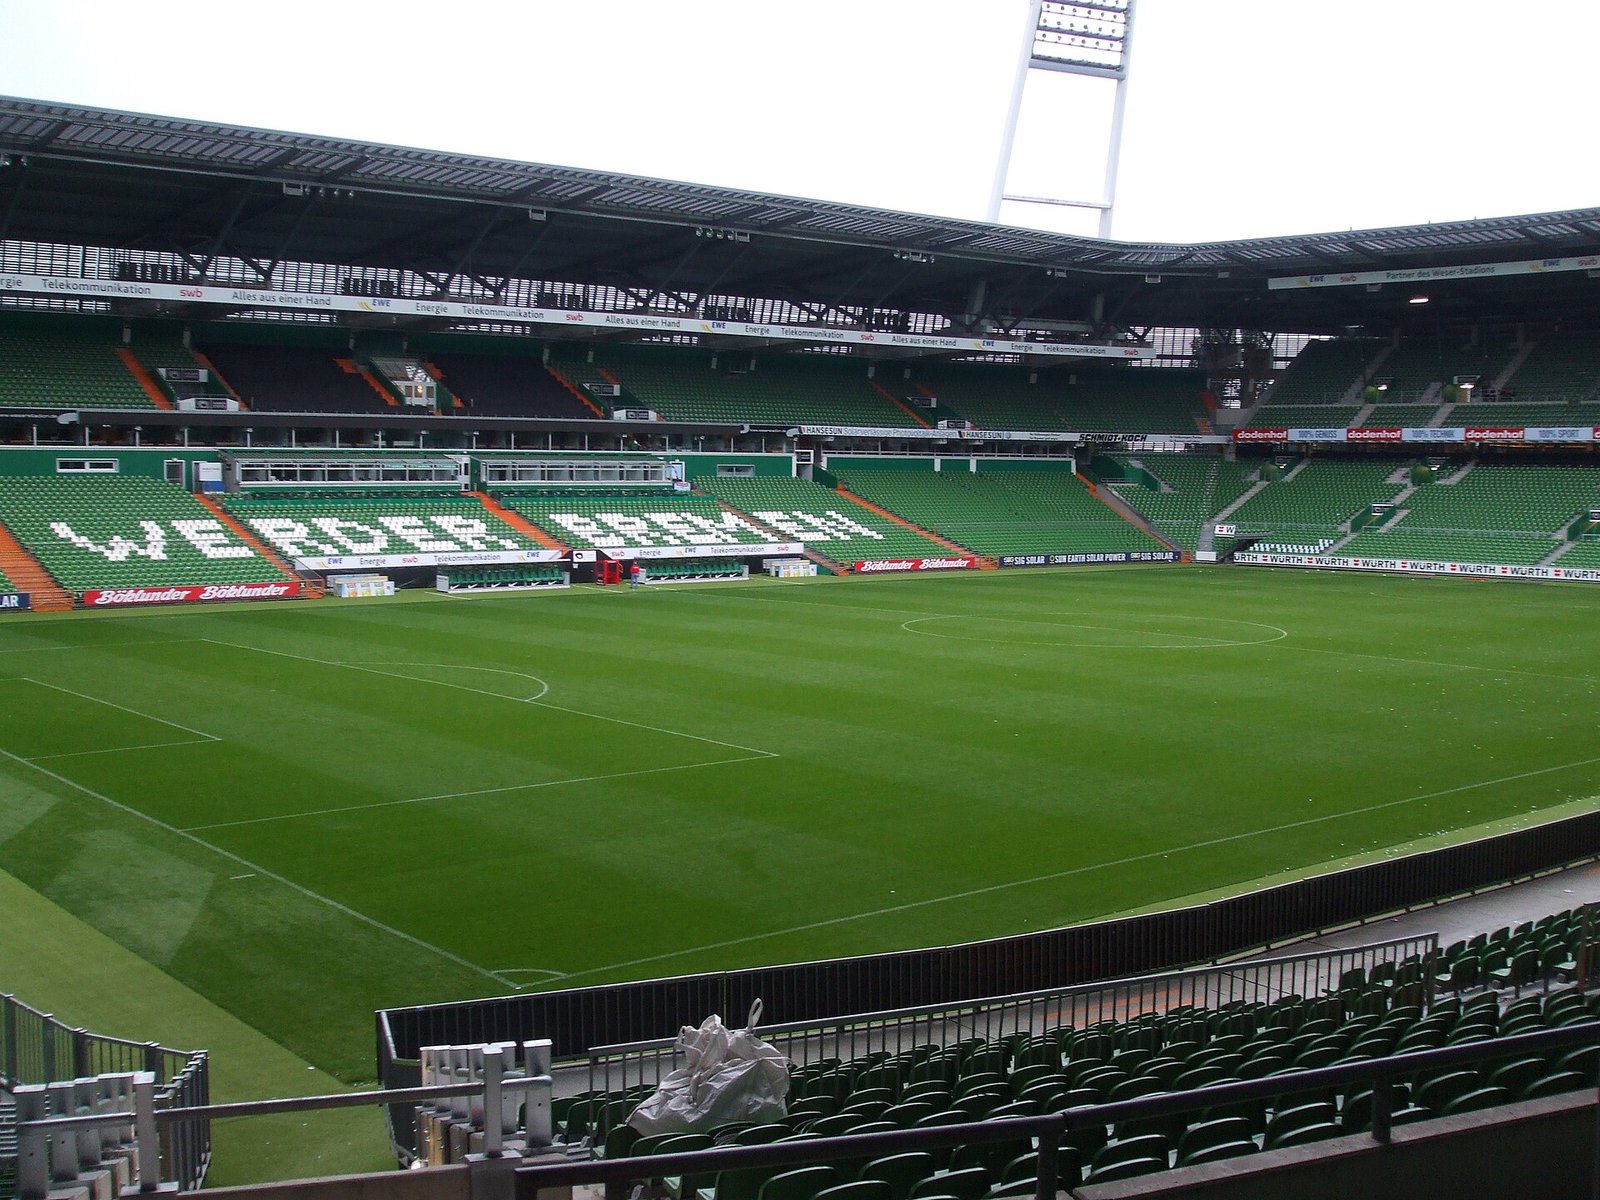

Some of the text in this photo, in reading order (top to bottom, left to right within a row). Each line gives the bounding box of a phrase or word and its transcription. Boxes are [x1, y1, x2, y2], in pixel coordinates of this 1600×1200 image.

[1386, 271, 1415, 279] Partner
[42, 278, 151, 295] Telekommunikation
[180, 288, 203, 298] swb
[232, 290, 331, 306] Alles aus einer Hand
[372, 298, 391, 307] EWE
[415, 302, 448, 314] Energie
[462, 305, 544, 320] Telekommunikation
[566, 312, 584, 322] swb
[605, 315, 681, 329] Alles aus einer Hand
[712, 321, 726, 329] EWE
[745, 325, 770, 336] Energie
[781, 327, 844, 340] Telekommunikation
[860, 334, 875, 342] swb
[891, 335, 909, 344] Alles
[922, 338, 938, 346] einer
[939, 339, 957, 348] Hand
[1011, 343, 1033, 352] Energie
[1043, 344, 1106, 356] Telekommunikation
[807, 426, 843, 435] HANSESUN
[967, 430, 1003, 439] HANSESUN
[1237, 429, 1287, 439] dodenhof
[1348, 429, 1402, 439] dodenhof
[1466, 429, 1524, 439] dodenhof
[49, 510, 885, 562] WERDER BREMEN
[527, 551, 540, 559] EWE
[639, 549, 662, 558] Energie
[685, 546, 697, 554] EWE
[711, 546, 765, 556] Telekommunikation
[402, 556, 418, 564] swb
[434, 553, 501, 563] Telekommunikation
[1026, 555, 1045, 564] SOLAR
[1055, 553, 1126, 564] SUN EARTH SOLAR POWER
[1152, 551, 1174, 560] SOLAR
[1270, 555, 1303, 564] WÜRTH
[328, 557, 343, 565] EWE
[359, 557, 386, 567] Energie
[861, 560, 914, 572] Böklunder
[918, 558, 970, 569] Böklunder
[1315, 557, 1349, 566] WÜRTH
[1362, 559, 1396, 568] WÜRTH
[1410, 561, 1445, 571] WÜRTH
[1459, 564, 1496, 574] WÜRTH
[1510, 567, 1548, 577] WÜRTH
[95, 588, 192, 605] Böklunder
[199, 584, 290, 600] Böklunder
